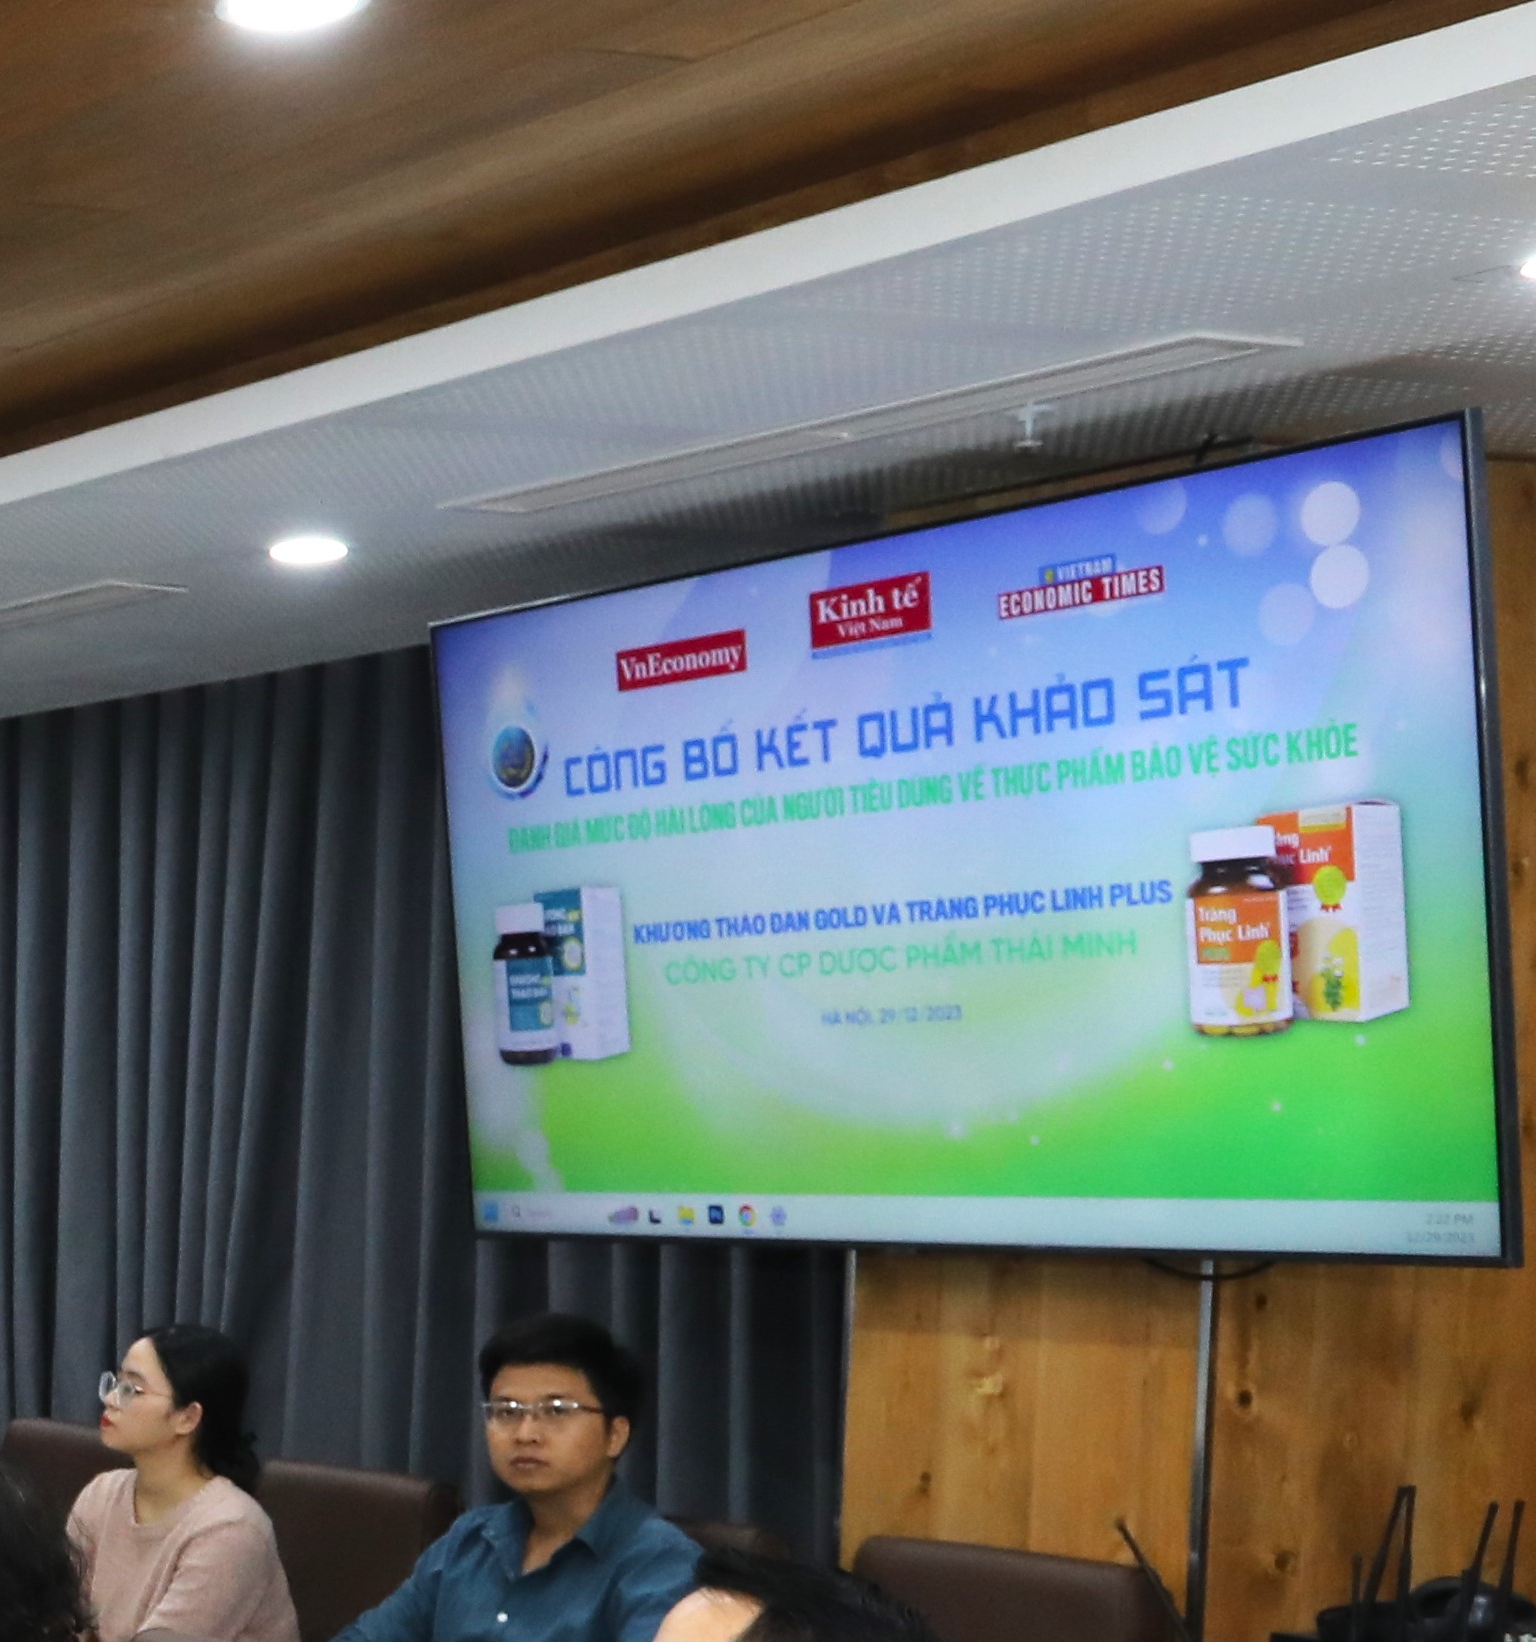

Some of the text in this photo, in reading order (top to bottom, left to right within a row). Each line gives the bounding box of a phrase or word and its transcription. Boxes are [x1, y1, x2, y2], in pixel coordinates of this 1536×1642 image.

[998, 568, 1162, 619] ECONOMIC TIMES
[1056, 557, 1113, 581] VIETNAM
[817, 574, 925, 625] Kinh tế
[837, 614, 903, 638] Việt Nam
[619, 642, 743, 683] VnEconomy
[565, 653, 1250, 797] CÔNG BỐ KẾT QUẢ KHẢO SÁT
[1225, 730, 1281, 772] SỨC
[815, 903, 867, 931] GOLD
[1050, 884, 1104, 912] LINH
[1109, 879, 1173, 908] PLUS
[742, 952, 772, 977] TY
[777, 951, 813, 978] CP
[1061, 929, 1138, 959] MINH
